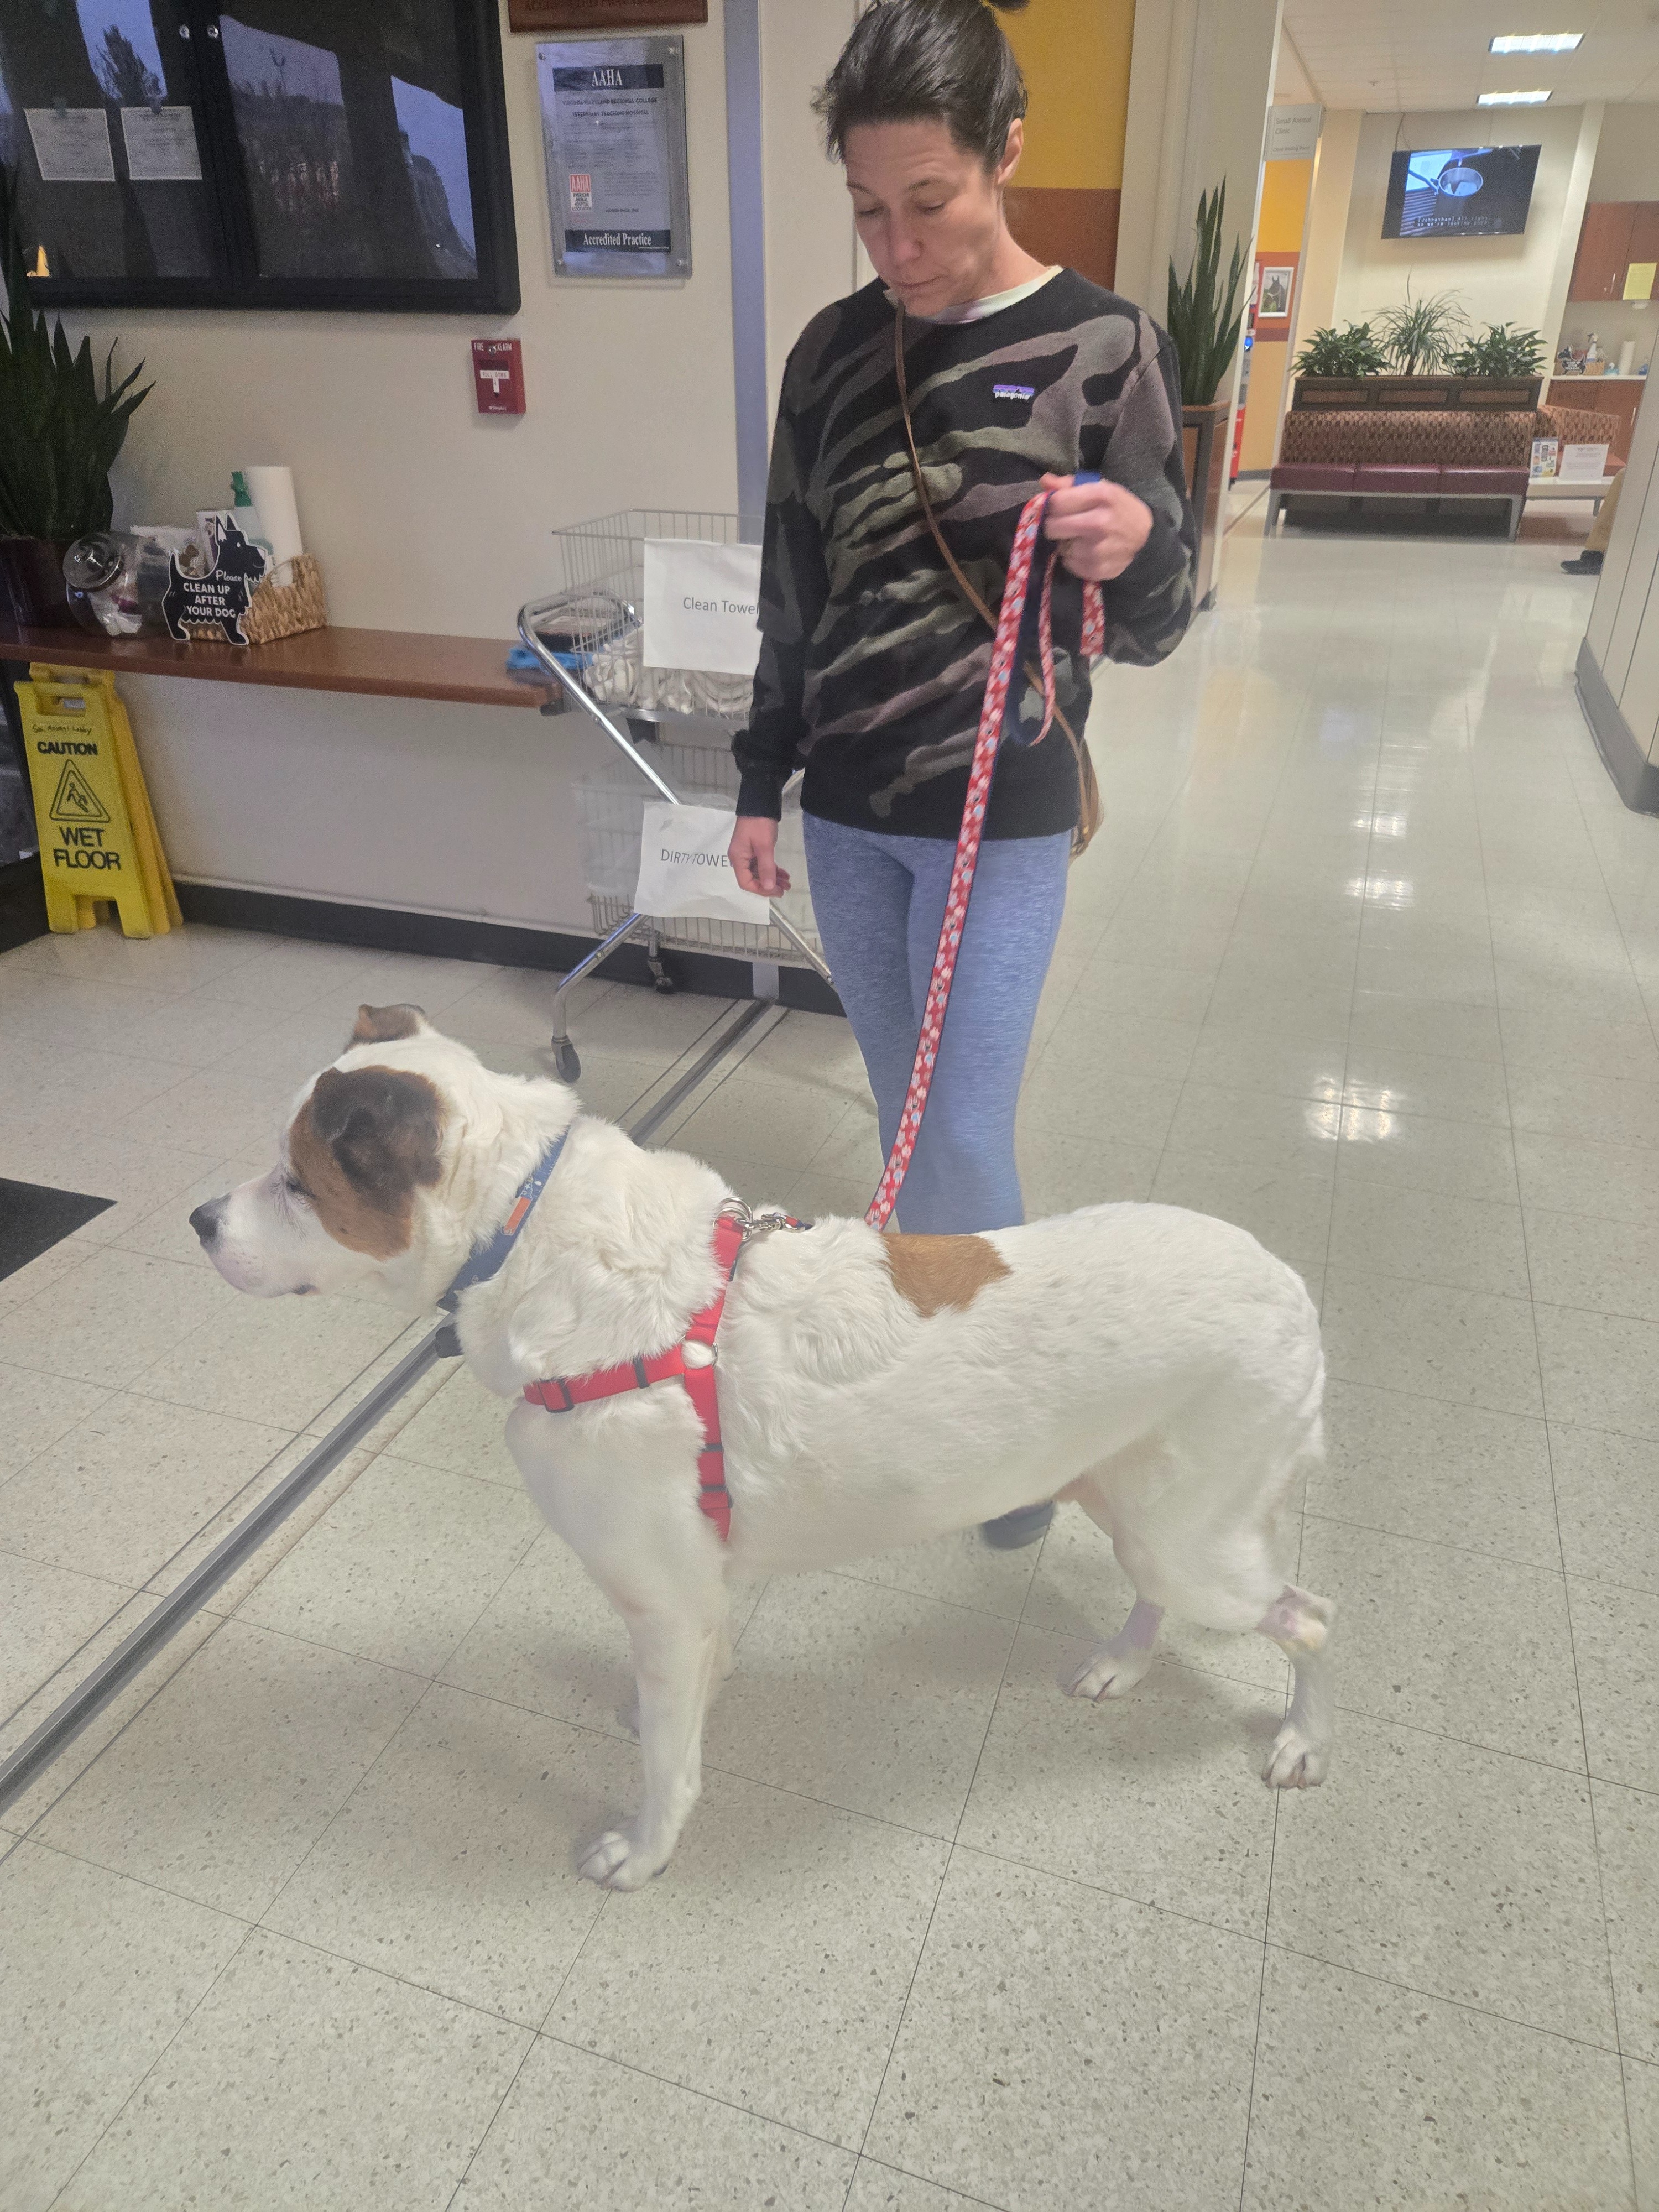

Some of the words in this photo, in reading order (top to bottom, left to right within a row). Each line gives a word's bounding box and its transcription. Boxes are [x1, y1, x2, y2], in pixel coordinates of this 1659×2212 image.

[592, 69, 623, 86] AAHA
[572, 175, 589, 191] AAHA
[583, 232, 620, 246] Accredited
[622, 232, 651, 246] Practice
[215, 570, 242, 582] Please
[183, 582, 215, 593] CLEAN
[217, 585, 231, 594] UP
[195, 594, 225, 606] AFTER
[683, 597, 718, 612] Clean
[186, 606, 213, 617] YOUR
[215, 608, 236, 618] DOG
[37, 741, 98, 755] CAUTION
[59, 826, 105, 847] WET
[53, 848, 121, 870] FLOOR
[661, 848, 692, 864] DIRTY
